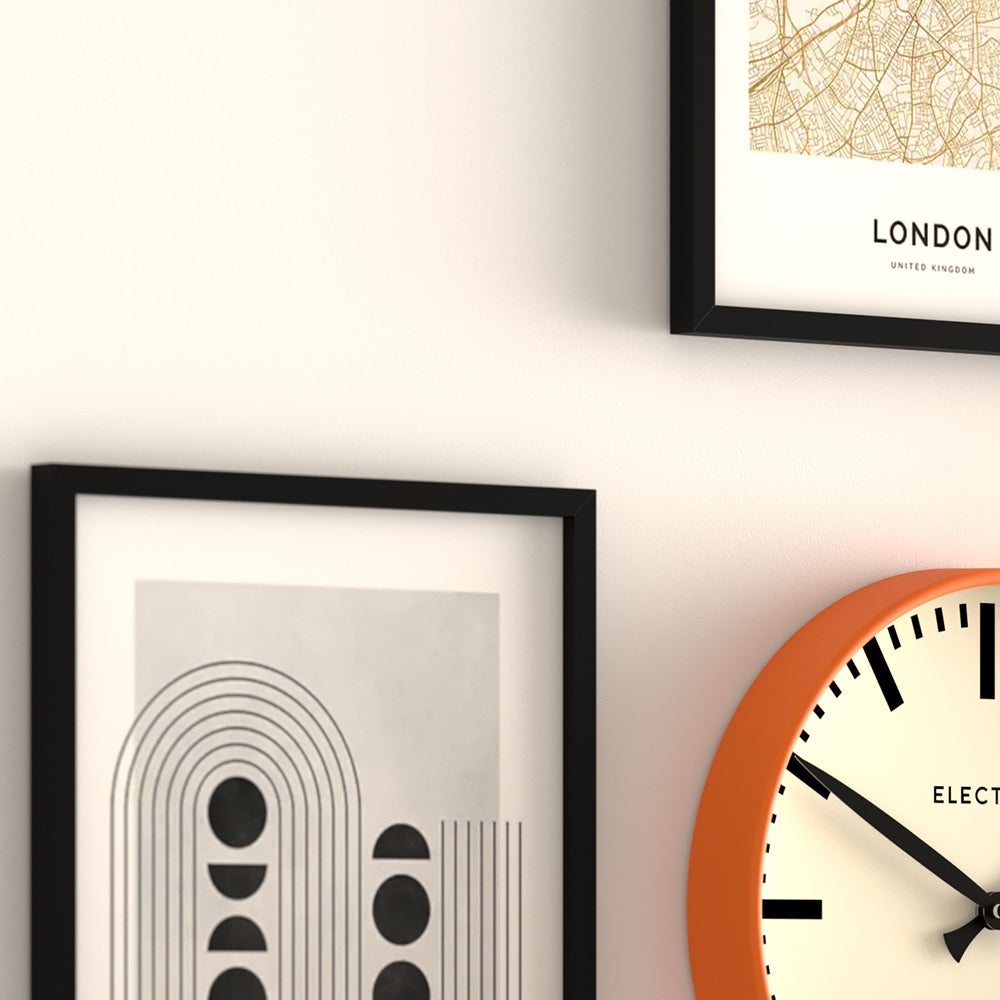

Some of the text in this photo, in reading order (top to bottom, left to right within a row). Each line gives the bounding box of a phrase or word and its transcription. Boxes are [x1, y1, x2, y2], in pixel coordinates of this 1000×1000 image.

[874, 218, 992, 252] LONDON
[890, 261, 976, 274] UNITED KINGDOM
